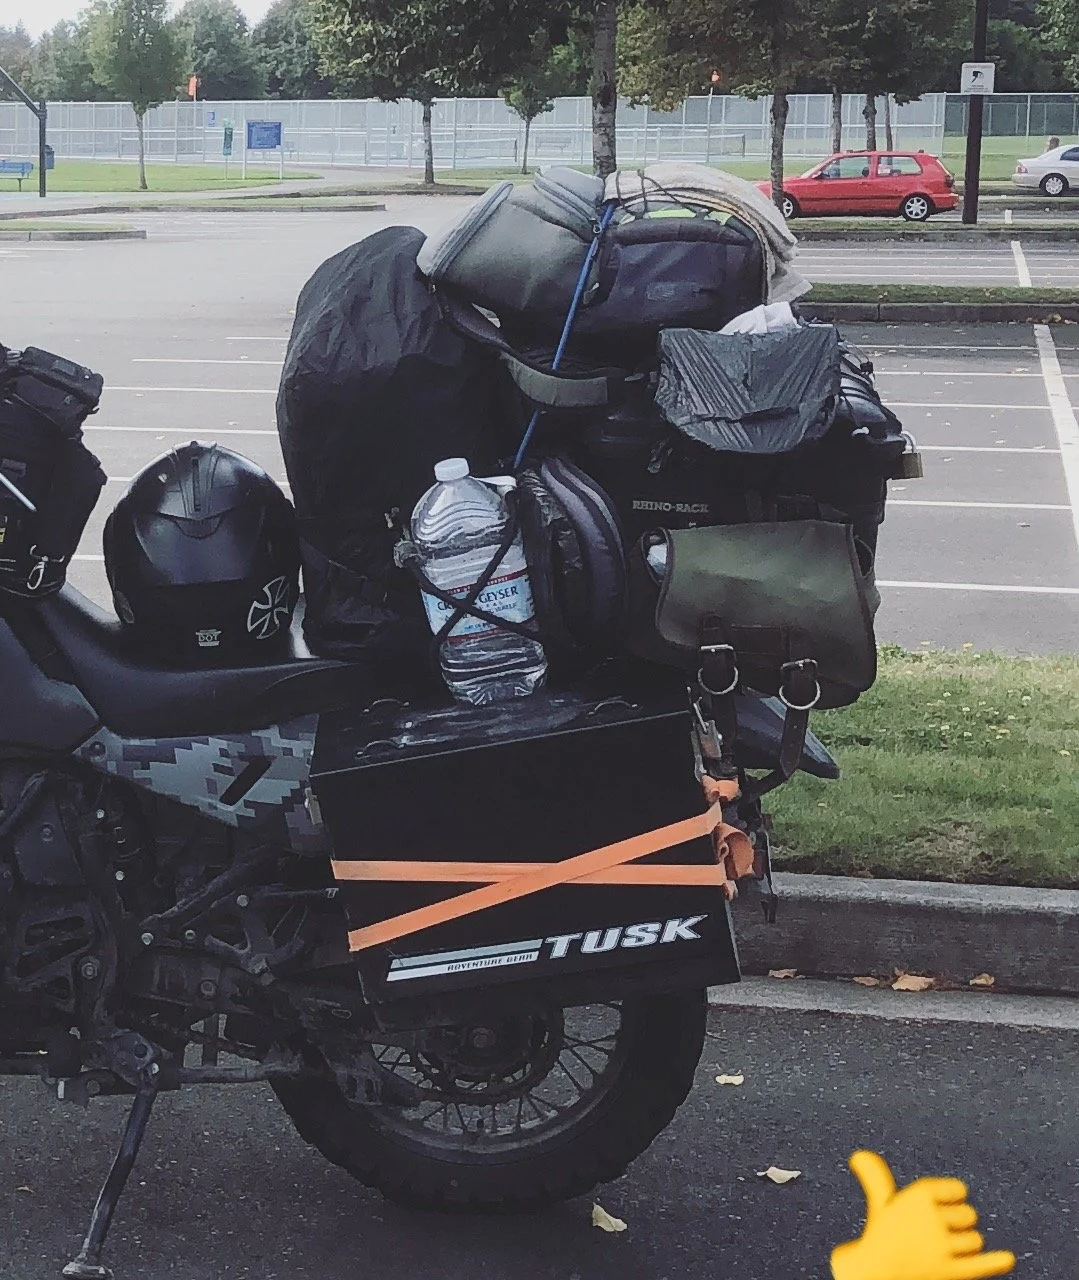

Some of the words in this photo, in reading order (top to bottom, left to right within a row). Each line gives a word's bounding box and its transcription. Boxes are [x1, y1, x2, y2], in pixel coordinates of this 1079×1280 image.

[632, 500, 709, 513] RHINO-RACK
[478, 585, 519, 604] GEYSER
[544, 913, 709, 960] TUSK
[446, 957, 503, 972] ADVENTURE
[506, 952, 534, 964] GEAR
